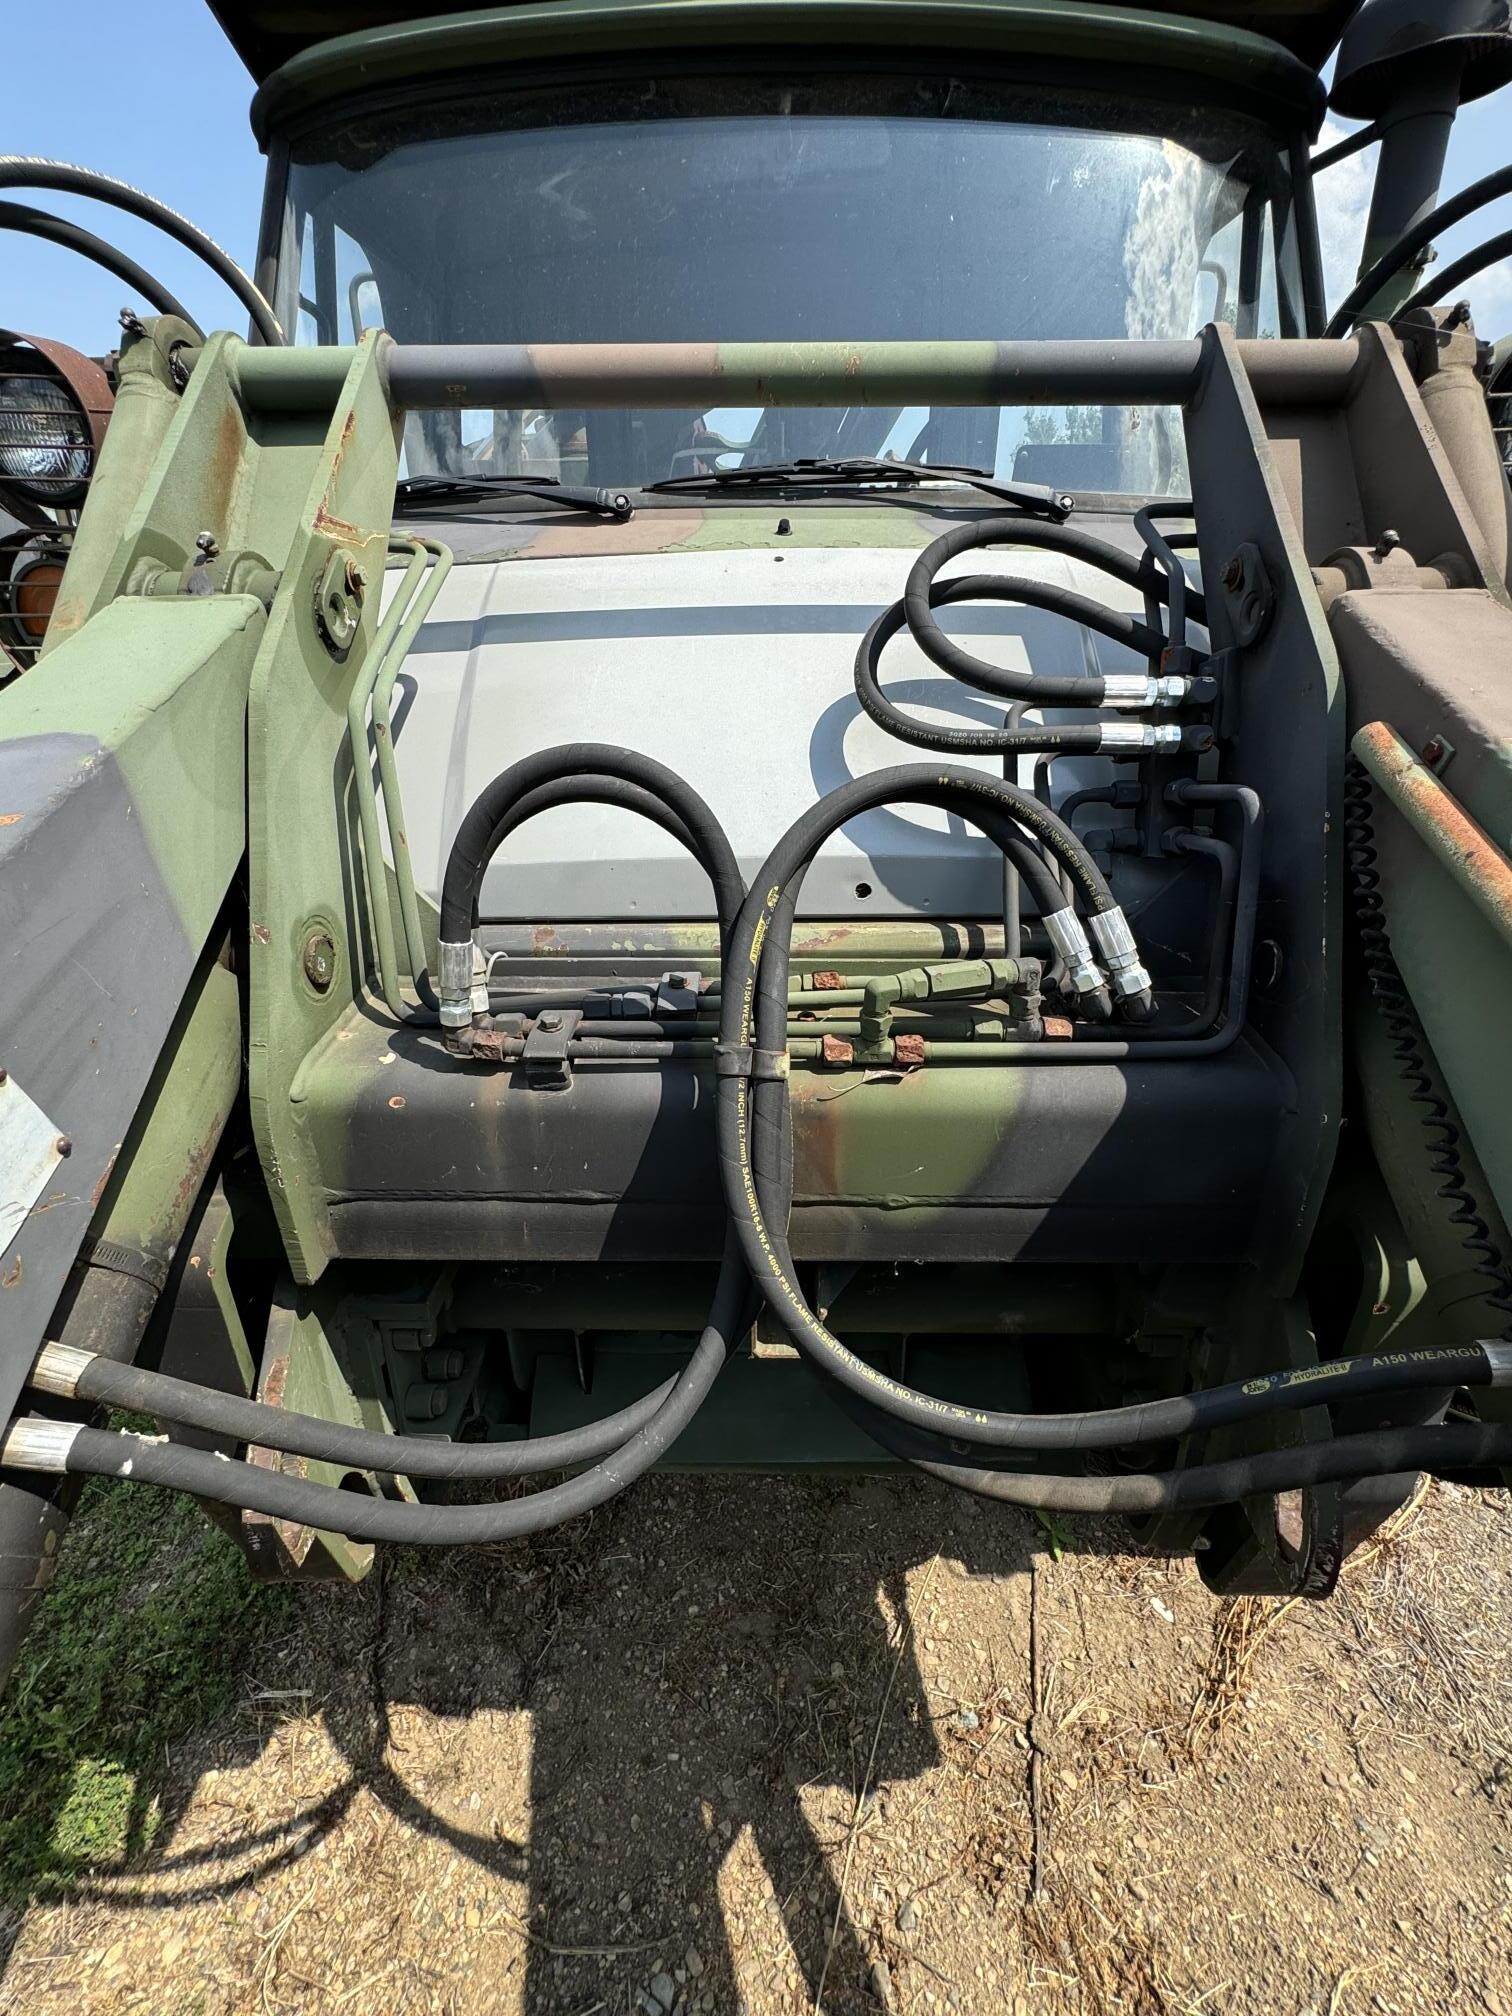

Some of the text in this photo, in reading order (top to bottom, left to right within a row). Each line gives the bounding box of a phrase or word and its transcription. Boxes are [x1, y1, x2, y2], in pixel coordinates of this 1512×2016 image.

[895, 722, 940, 742] RESISTANT
[1047, 826, 1082, 868] RESISTANT
[1078, 867, 1097, 896] FLAME
[744, 977, 753, 1002] A150
[738, 1092, 746, 1117] INCH
[737, 1119, 749, 1165] (12.7mm)
[758, 1231, 771, 1254] W.P.
[767, 1254, 782, 1276] 4000
[779, 1275, 792, 1293] PSI
[789, 1292, 814, 1324] FLAME
[811, 1321, 857, 1366] RESISTANT
[1372, 1353, 1407, 1367] A150
[1294, 1365, 1339, 1381] HYDRALITE
[895, 1386, 913, 1401] NO.
